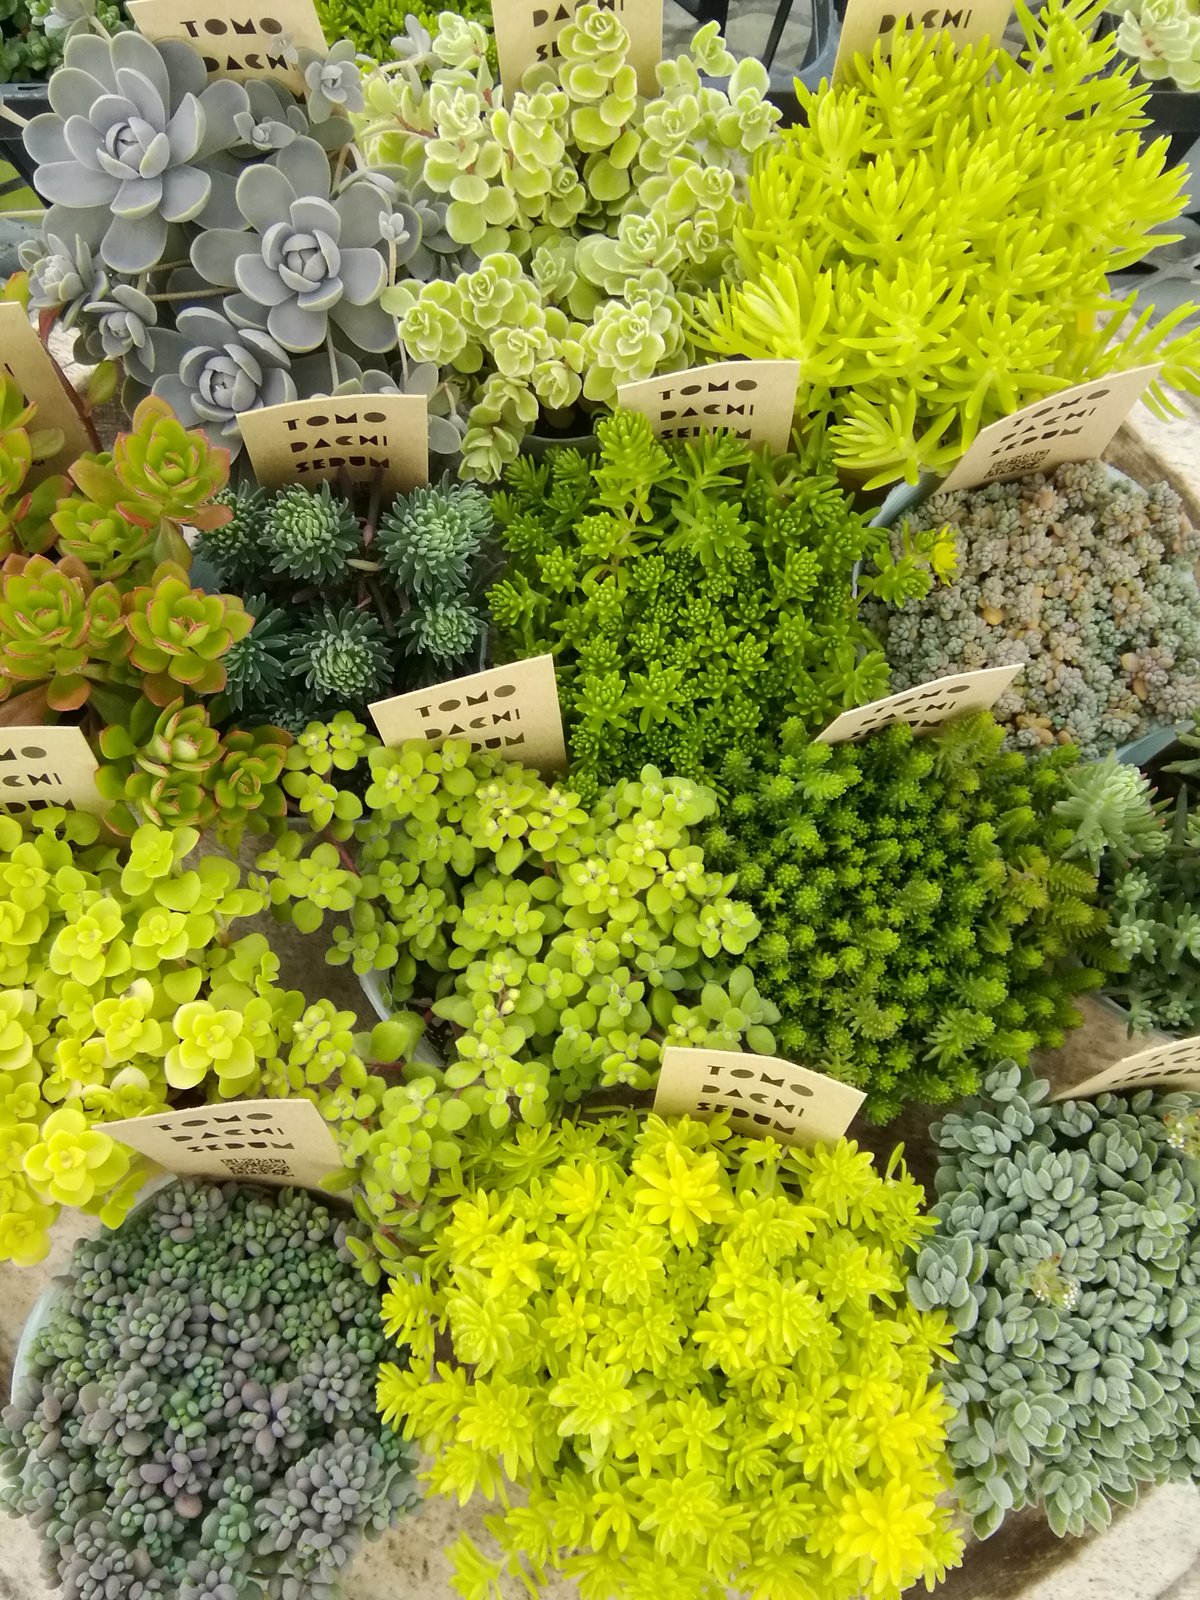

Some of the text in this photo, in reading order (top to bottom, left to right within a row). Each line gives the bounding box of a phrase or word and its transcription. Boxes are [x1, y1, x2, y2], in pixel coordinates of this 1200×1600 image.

[180, 18, 282, 37] TOMO
[659, 380, 757, 400] TOMO
[661, 404, 753, 420] DACHI
[1013, 389, 1110, 427] TOMO
[283, 412, 386, 430] TOMO
[1000, 407, 1097, 443] DACHI
[291, 435, 387, 453] DACHI
[989, 425, 1083, 457] SEDUM
[296, 456, 390, 473] SEDUM
[415, 684, 516, 718] TOMO
[874, 685, 970, 714] TOMO
[425, 708, 520, 740] DACHI
[860, 701, 956, 726] DACHI
[707, 1065, 814, 1097] TOMO
[701, 1084, 804, 1117] DACHI
[153, 1112, 273, 1131] TOMO
[696, 1102, 796, 1135] SEDUM
[171, 1127, 284, 1142] DACHI
[187, 1141, 295, 1152] SEDUM
